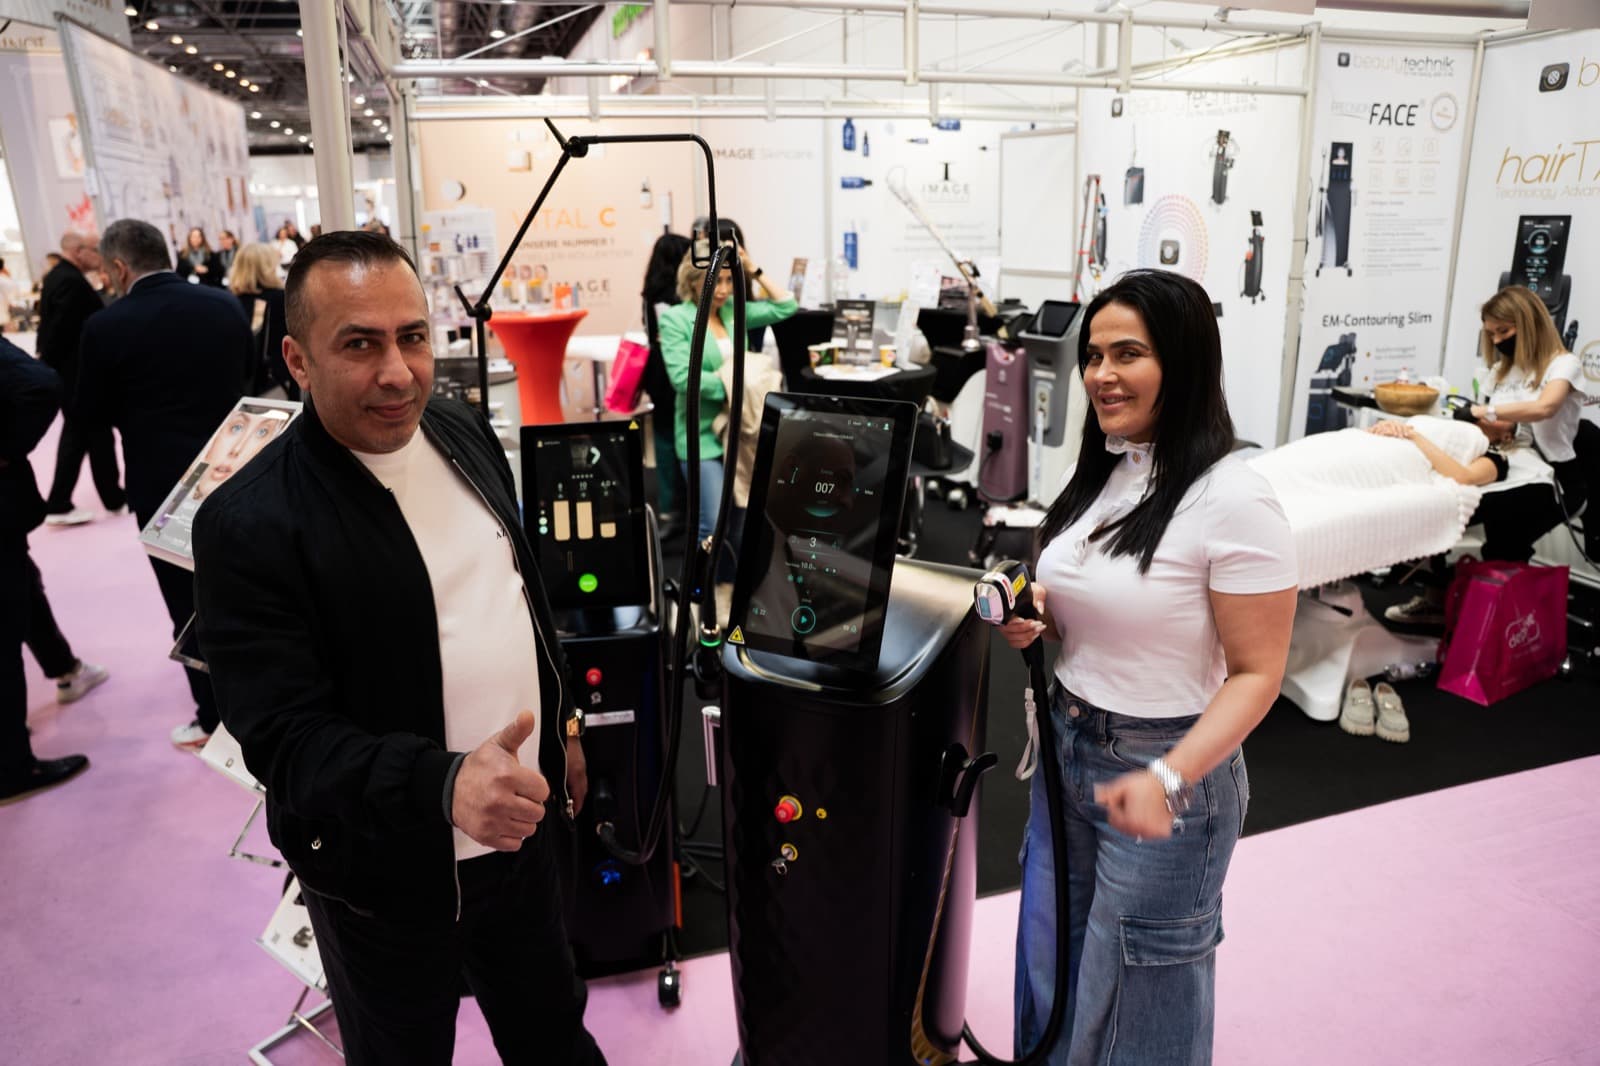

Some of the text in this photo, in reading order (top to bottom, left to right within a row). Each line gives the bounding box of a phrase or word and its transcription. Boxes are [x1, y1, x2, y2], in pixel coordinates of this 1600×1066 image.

[1369, 102, 1420, 126] FACE
[922, 184, 970, 195] IMAGE
[599, 207, 616, 228] C
[1322, 311, 1433, 328] EM-Contouring Slim
[815, 481, 836, 494] 007
